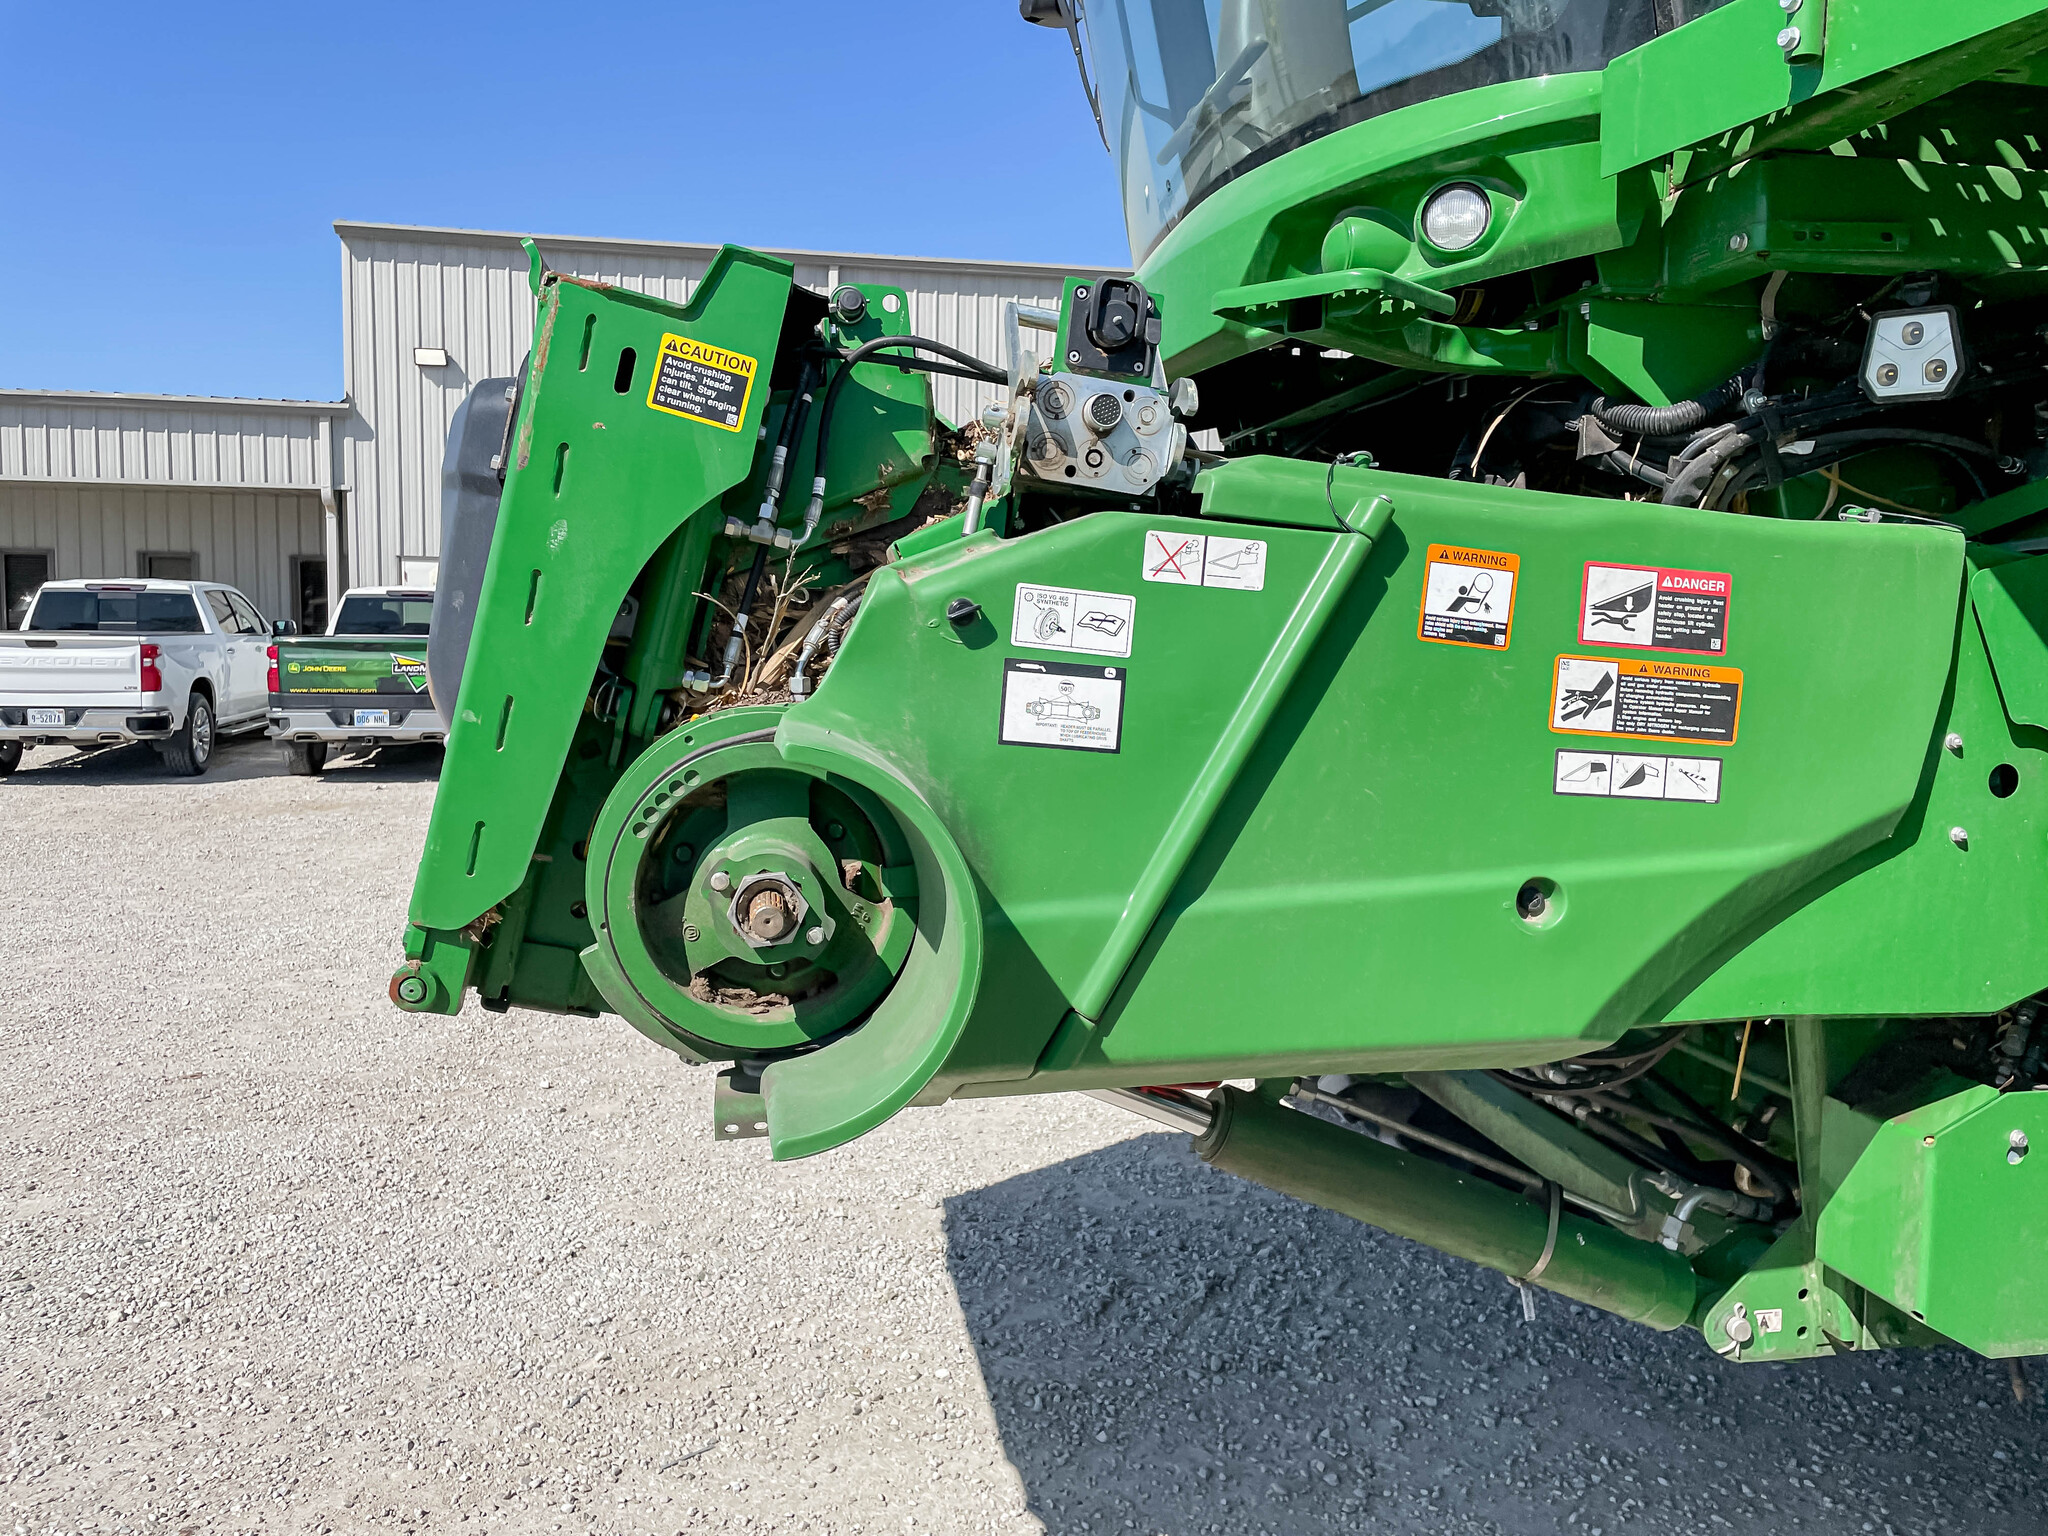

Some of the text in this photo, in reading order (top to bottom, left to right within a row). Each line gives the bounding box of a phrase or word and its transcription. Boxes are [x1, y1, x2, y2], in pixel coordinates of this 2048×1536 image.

[680, 342, 752, 374] CAUTION
[666, 357, 731, 383] Avoid crushing
[661, 376, 717, 398] can tilt. Stay
[703, 377, 734, 392] Header
[659, 385, 737, 412] clear when engine
[667, 397, 703, 413] running.
[1453, 551, 1507, 567] WARNING
[1674, 577, 1725, 592] DANGER
[1037, 599, 1069, 607] SYNTHETIC
[1654, 665, 1710, 678] WARNING
[1760, 1315, 1769, 1329] A
